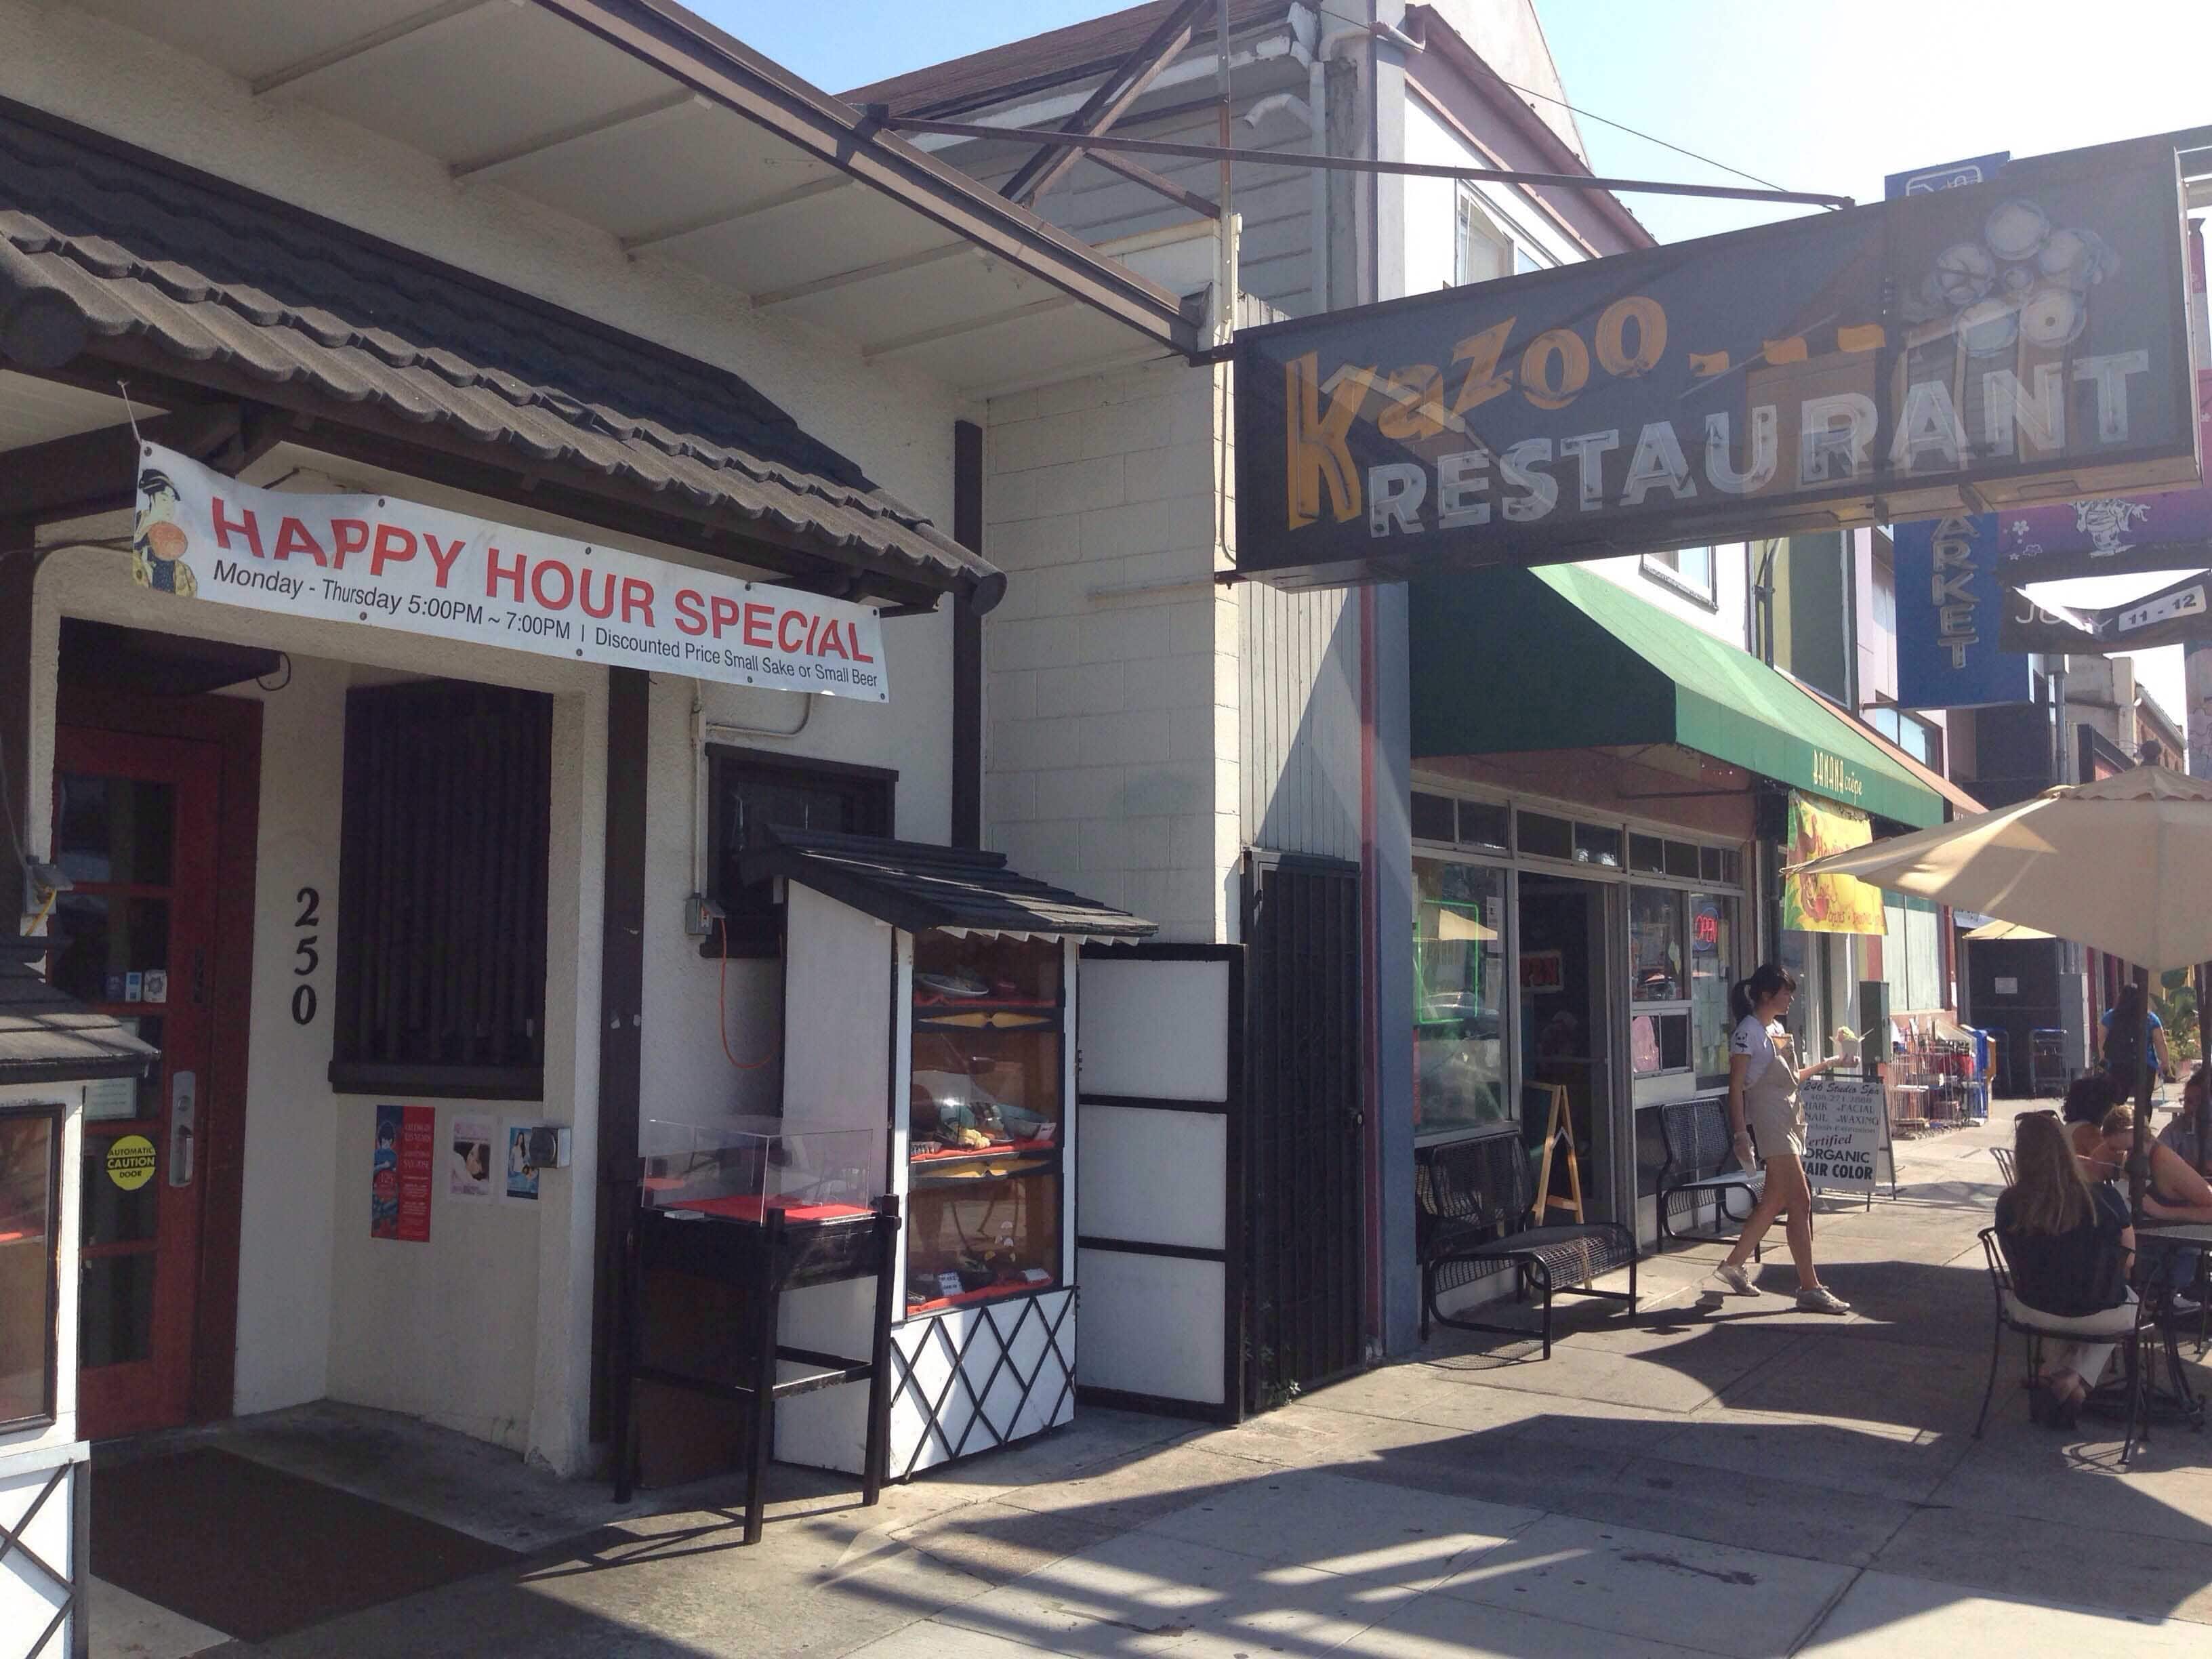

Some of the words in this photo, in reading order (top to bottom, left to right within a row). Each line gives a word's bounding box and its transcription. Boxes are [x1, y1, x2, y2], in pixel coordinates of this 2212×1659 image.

[1368, 349, 2150, 538] RESTAURANT
[211, 496, 466, 589] HAPPY
[486, 548, 655, 628] HOUR
[674, 589, 874, 663] SPECIAL
[1930, 515, 1981, 670] ARKET
[213, 559, 304, 600] Monday
[322, 579, 403, 615] Thursday
[408, 594, 483, 625] 5:00PM
[506, 612, 571, 640] 7:00PM
[596, 628, 680, 658] Discounted
[685, 642, 720, 665] Price
[724, 649, 759, 672] Small
[762, 657, 795, 677] Sake
[799, 666, 812, 678] or
[815, 663, 849, 684] Small
[853, 667, 878, 687] Beer
[2128, 610, 2148, 625] 11
[2172, 593, 2197, 610] 12
[1813, 749, 1844, 794] BANANA
[1695, 916, 1719, 943] OPEN
[291, 886, 321, 1025] 250
[1826, 1082, 1857, 1093] Studio
[1860, 1084, 1879, 1096] Spa
[108, 1147, 155, 1156] AUTOMATIC
[1804, 1147, 1871, 1164] ORGANIC
[1806, 1134, 1853, 1149] ertified
[107, 1156, 156, 1169] CAUTION
[1832, 1164, 1873, 1180] COLOR
